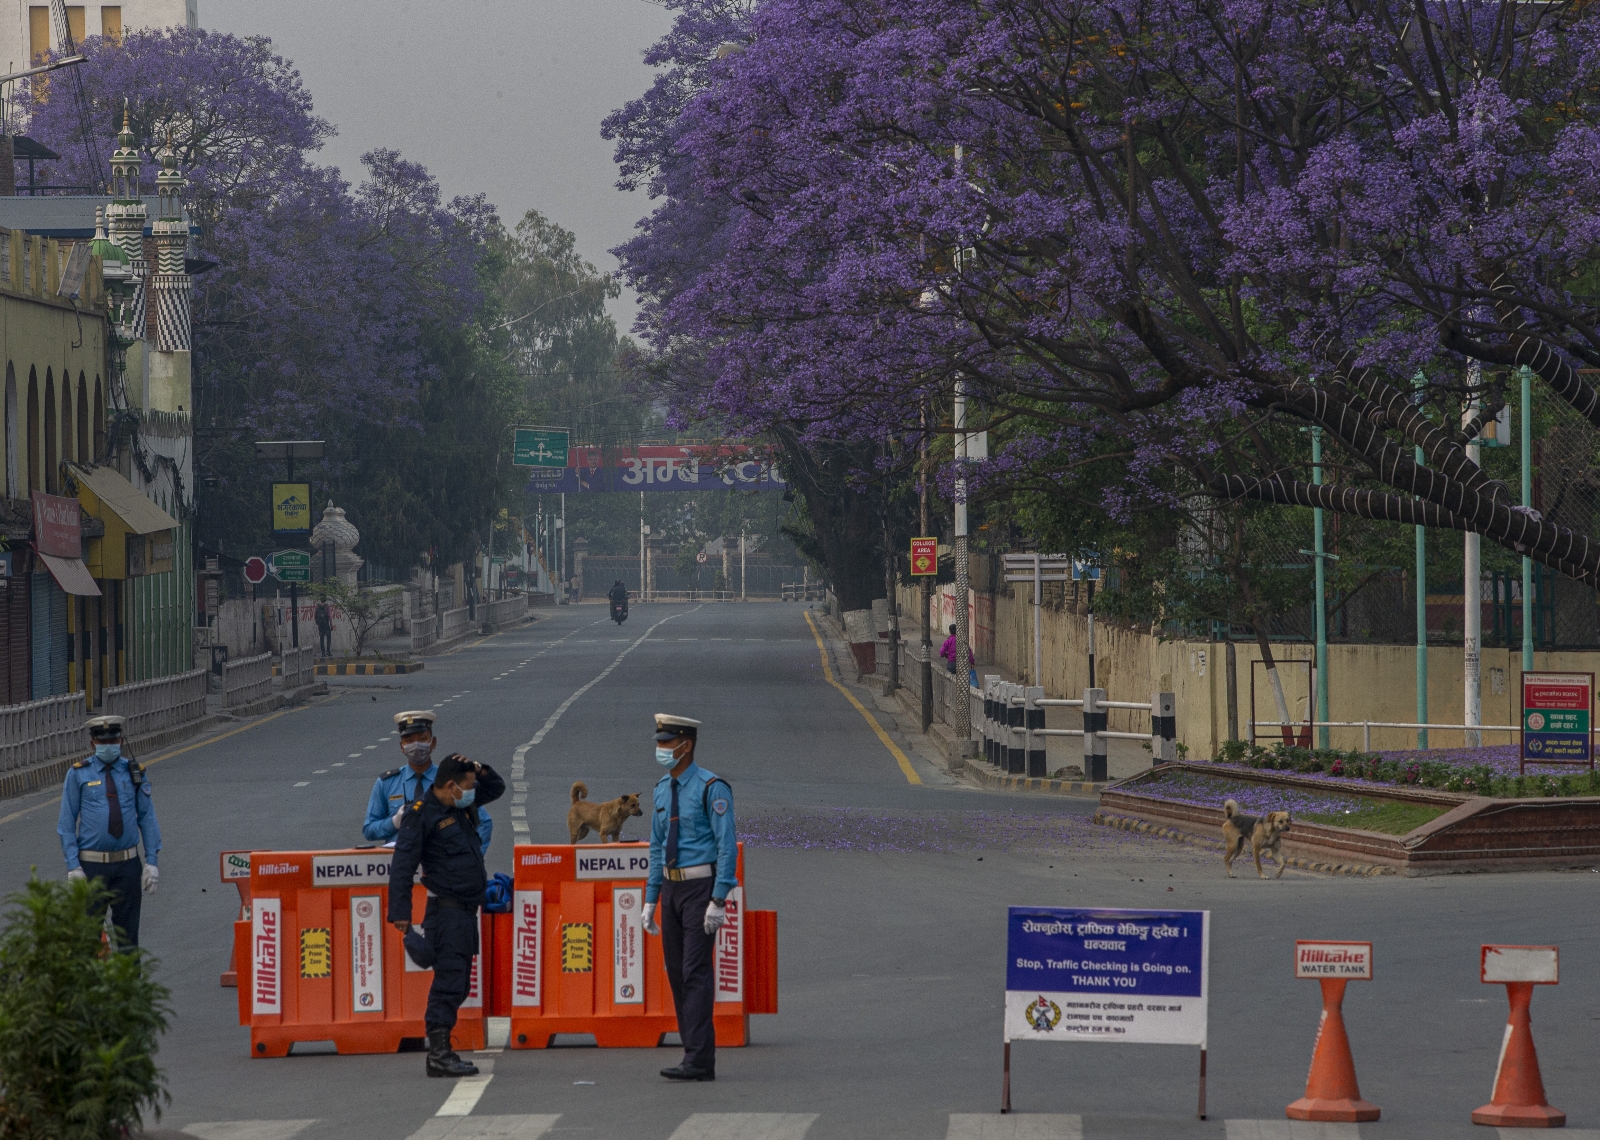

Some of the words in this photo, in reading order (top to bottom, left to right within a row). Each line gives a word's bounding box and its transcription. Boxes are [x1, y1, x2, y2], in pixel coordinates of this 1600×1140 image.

[521, 853, 562, 866] Hilltake
[580, 858, 625, 871] NEPAL
[630, 858, 649, 870] PO
[258, 862, 300, 876] Hilltake
[316, 864, 362, 878] NEPAL
[1076, 922, 1114, 936] ट्राफिक
[516, 903, 538, 998] Hilltake
[718, 899, 738, 993] Hilltake
[1084, 940, 1126, 952] धन्यवाद
[256, 911, 276, 1006] Hilltake
[1300, 949, 1364, 963] Hilltake
[1016, 958, 1043, 970] Stop,
[1046, 959, 1079, 970] Traffic
[1081, 960, 1128, 973] Checking
[1131, 962, 1140, 972] is
[1142, 963, 1172, 974] Going
[1175, 965, 1191, 974] on.
[1302, 965, 1335, 973] WATER
[1072, 975, 1110, 986] THANK
[1114, 977, 1137, 988] YOU
